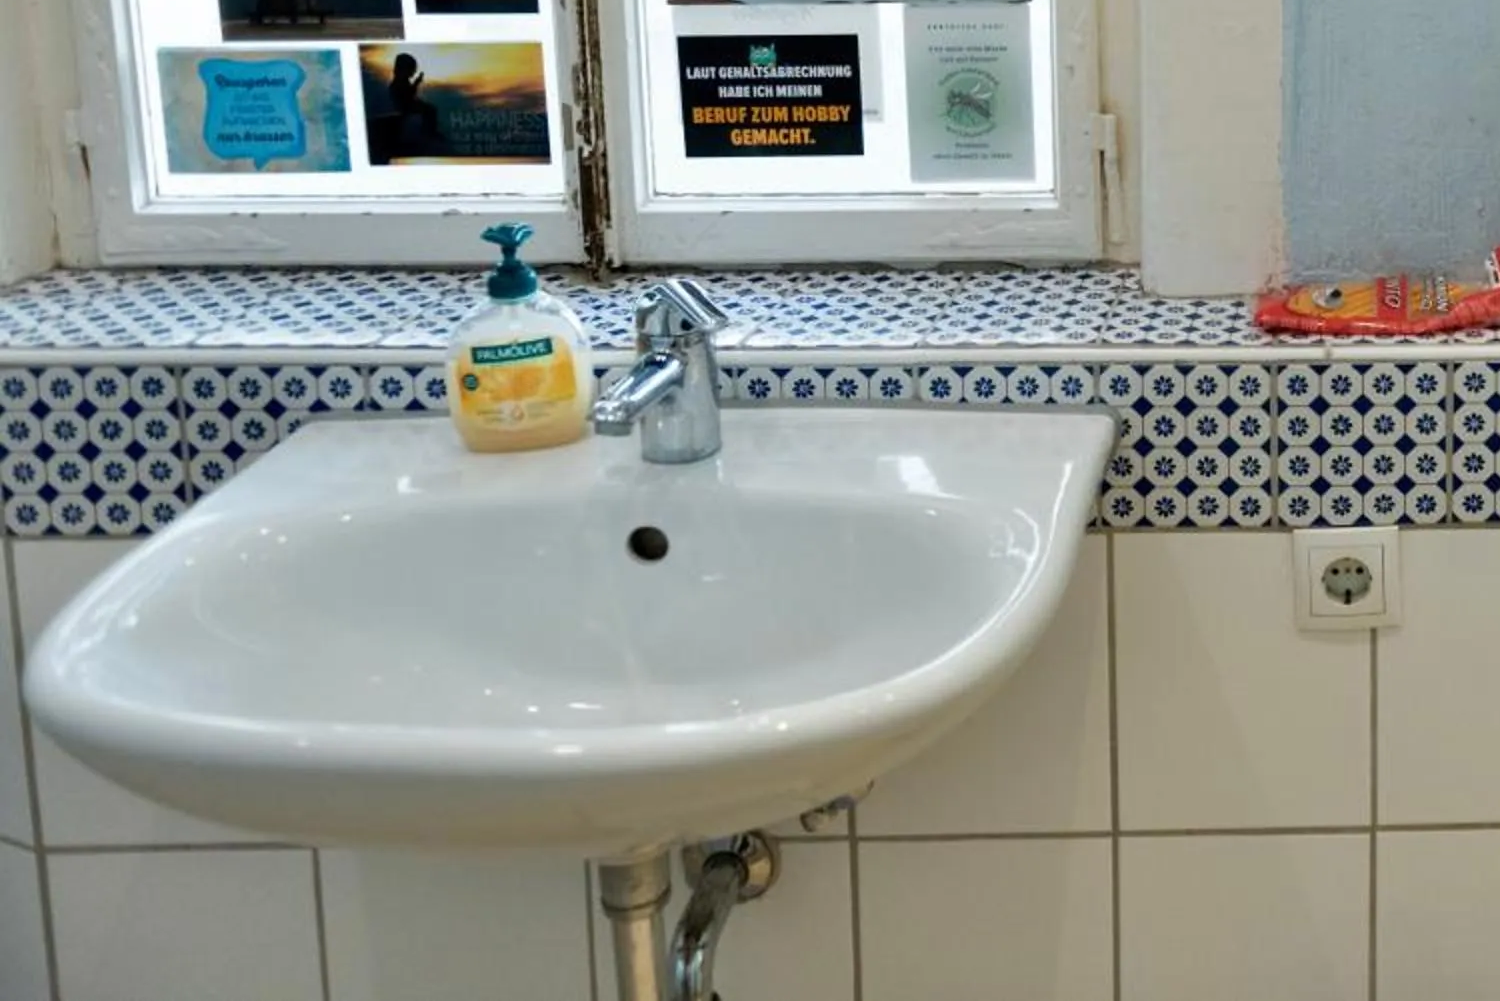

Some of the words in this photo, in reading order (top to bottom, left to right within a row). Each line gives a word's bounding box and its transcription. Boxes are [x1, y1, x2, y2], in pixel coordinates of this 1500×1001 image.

[686, 66, 716, 79] LAUT
[718, 65, 852, 79] GEHALTSABRECHNUNG
[718, 85, 750, 98] HABE
[753, 85, 773, 97] ICH
[776, 84, 823, 97] MEINEN
[449, 110, 544, 131] HAPPINESS
[692, 106, 747, 124] BERUF
[751, 106, 789, 123] ZUM
[792, 105, 851, 123] HOBBY
[730, 128, 817, 146] GEMACHT.
